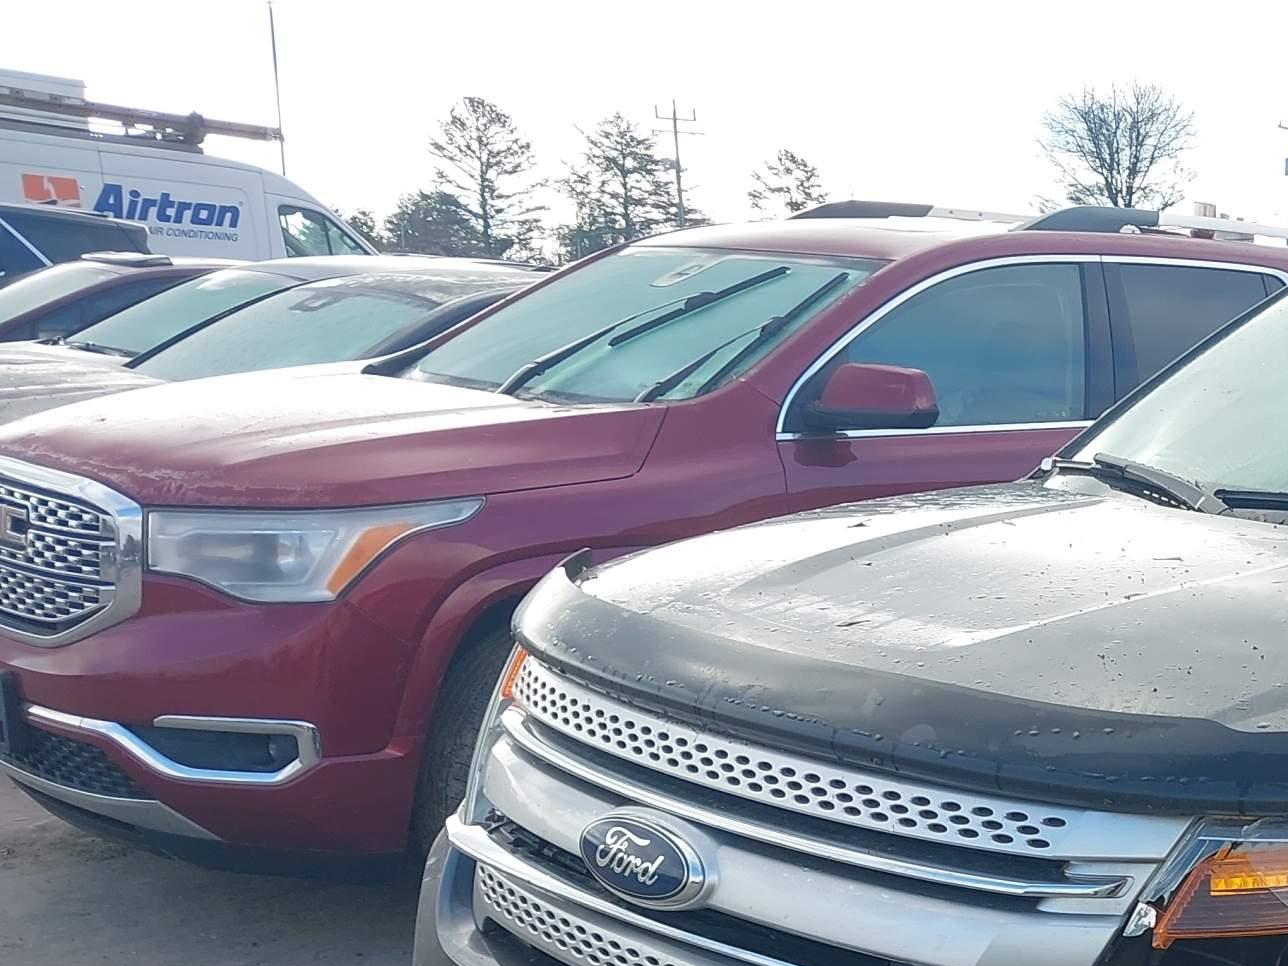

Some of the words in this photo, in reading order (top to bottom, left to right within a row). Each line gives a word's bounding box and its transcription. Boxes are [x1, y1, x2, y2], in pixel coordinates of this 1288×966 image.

[94, 183, 240, 229] Airtron
[166, 227, 239, 243] CONDITIONING
[595, 826, 665, 886] Ford
